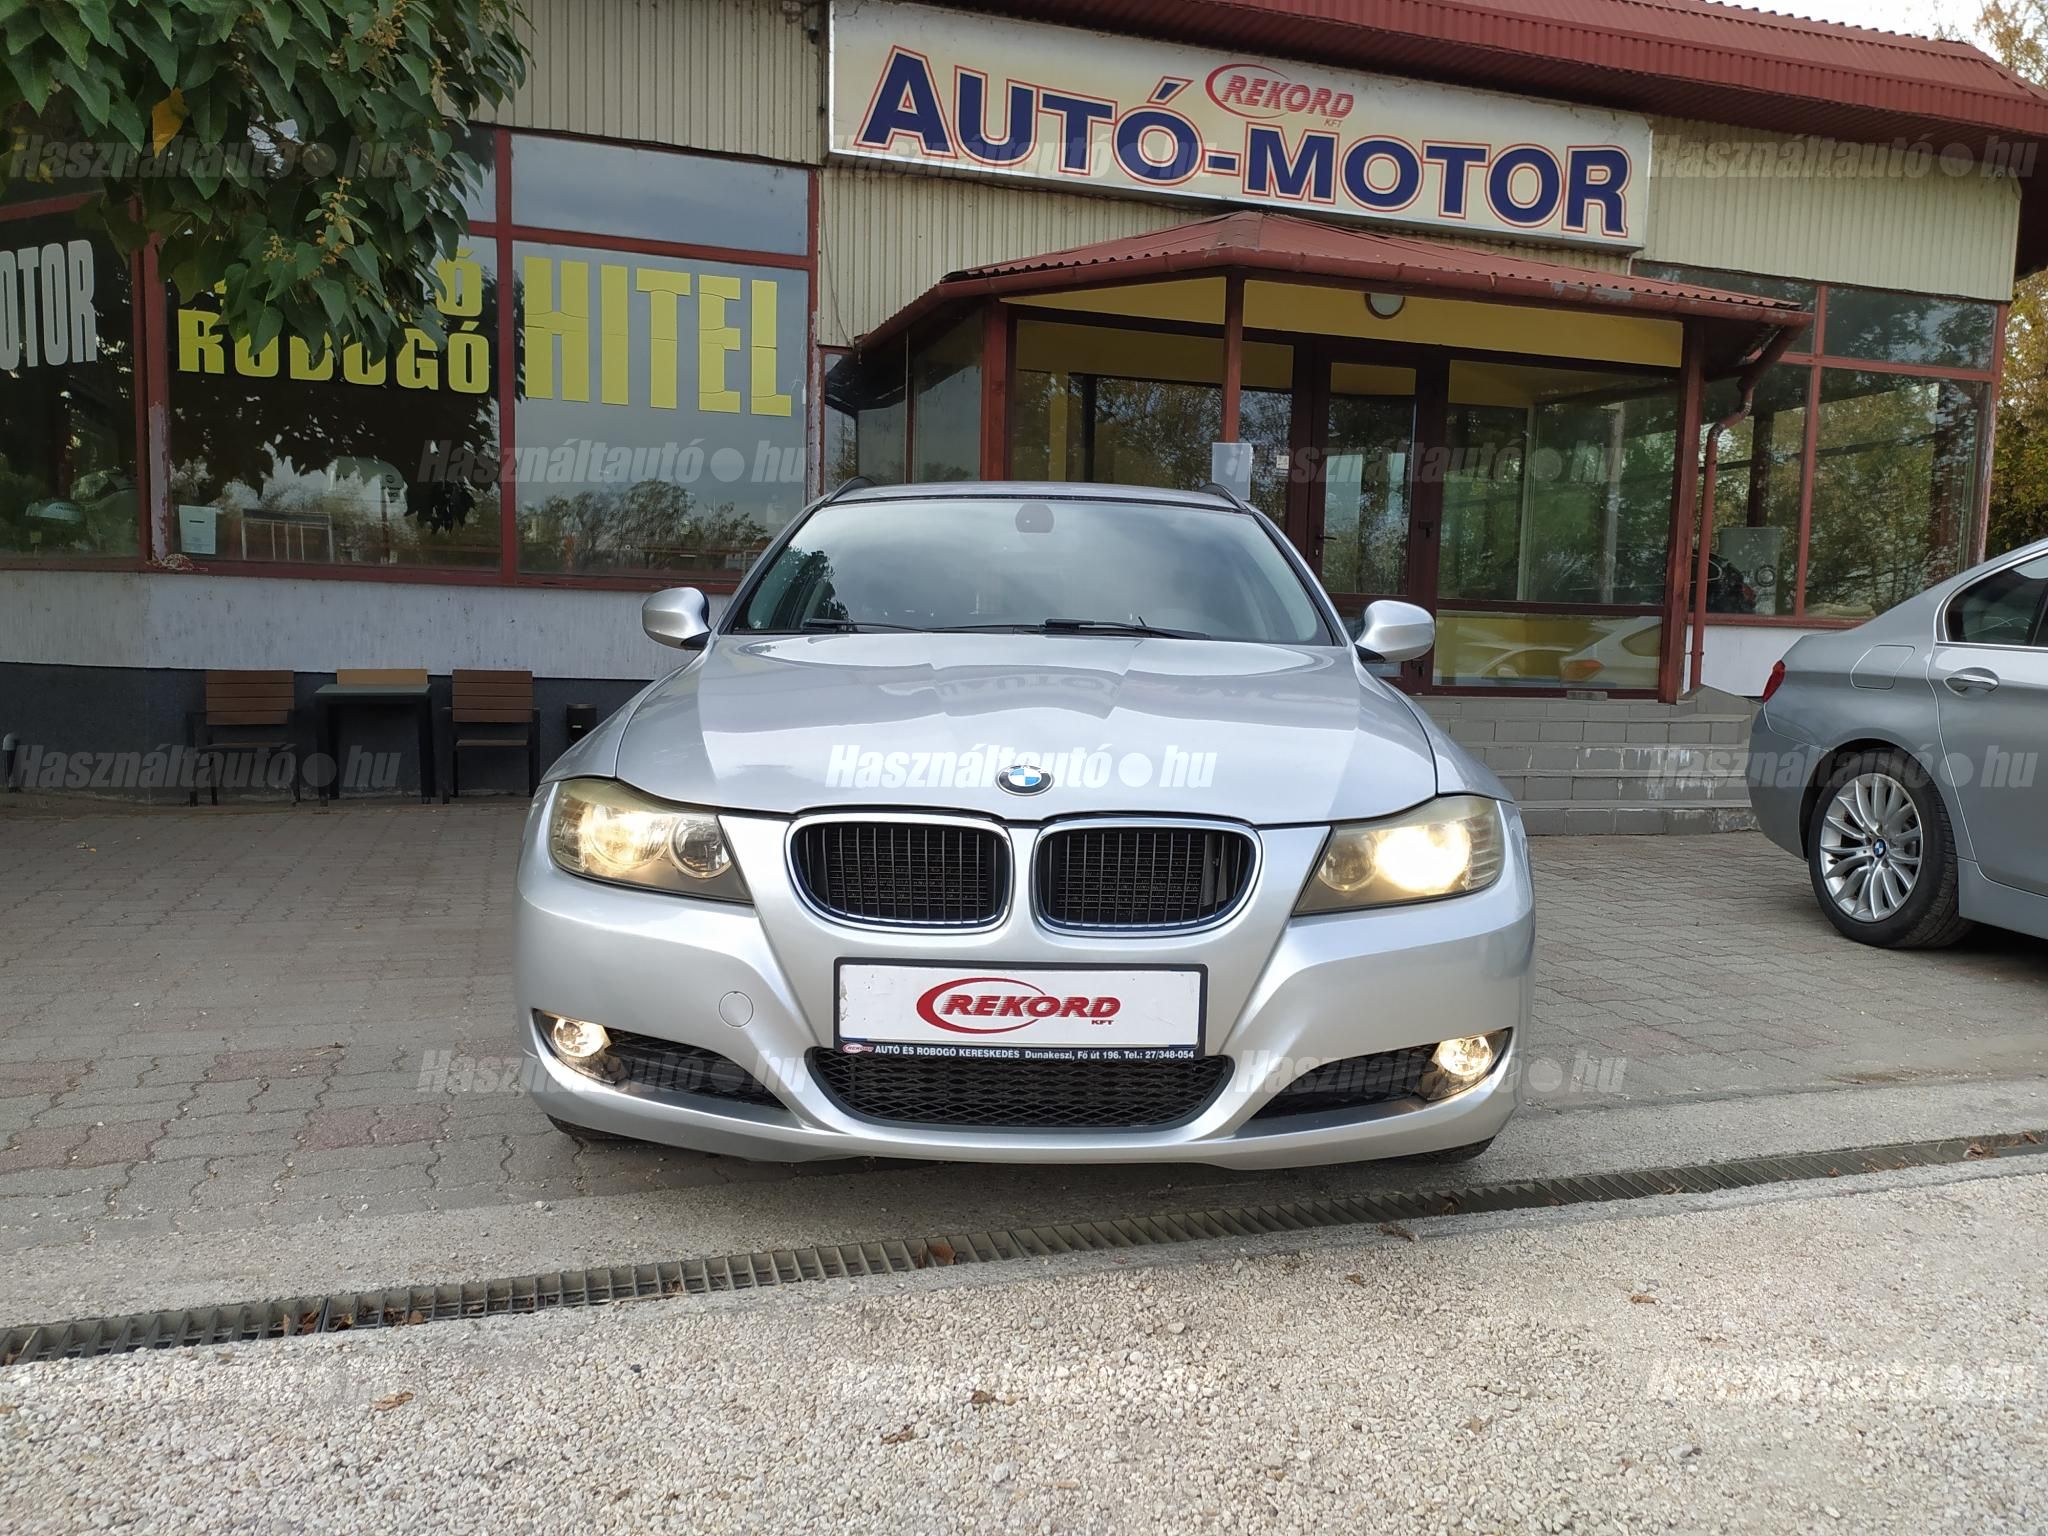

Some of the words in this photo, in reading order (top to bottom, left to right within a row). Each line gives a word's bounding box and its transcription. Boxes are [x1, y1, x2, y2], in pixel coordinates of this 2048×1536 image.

[1221, 75, 1354, 119] REKORD
[855, 46, 1631, 239] AUTÓ-MOTOR
[524, 256, 792, 417] HITEL
[941, 994, 1121, 1018] REKORD
[875, 1044, 899, 1055] AUTÓ
[902, 1044, 915, 1055] ÉS
[917, 1045, 957, 1057] ROBOGÓ
[959, 1047, 1020, 1059] KERESKEDÉS
[1025, 1050, 1075, 1060] Dunakeszi,
[1103, 1050, 1122, 1060] 196.
[1124, 1050, 1143, 1059] Tel.:
[1145, 1050, 1195, 1060] 27/348-054
